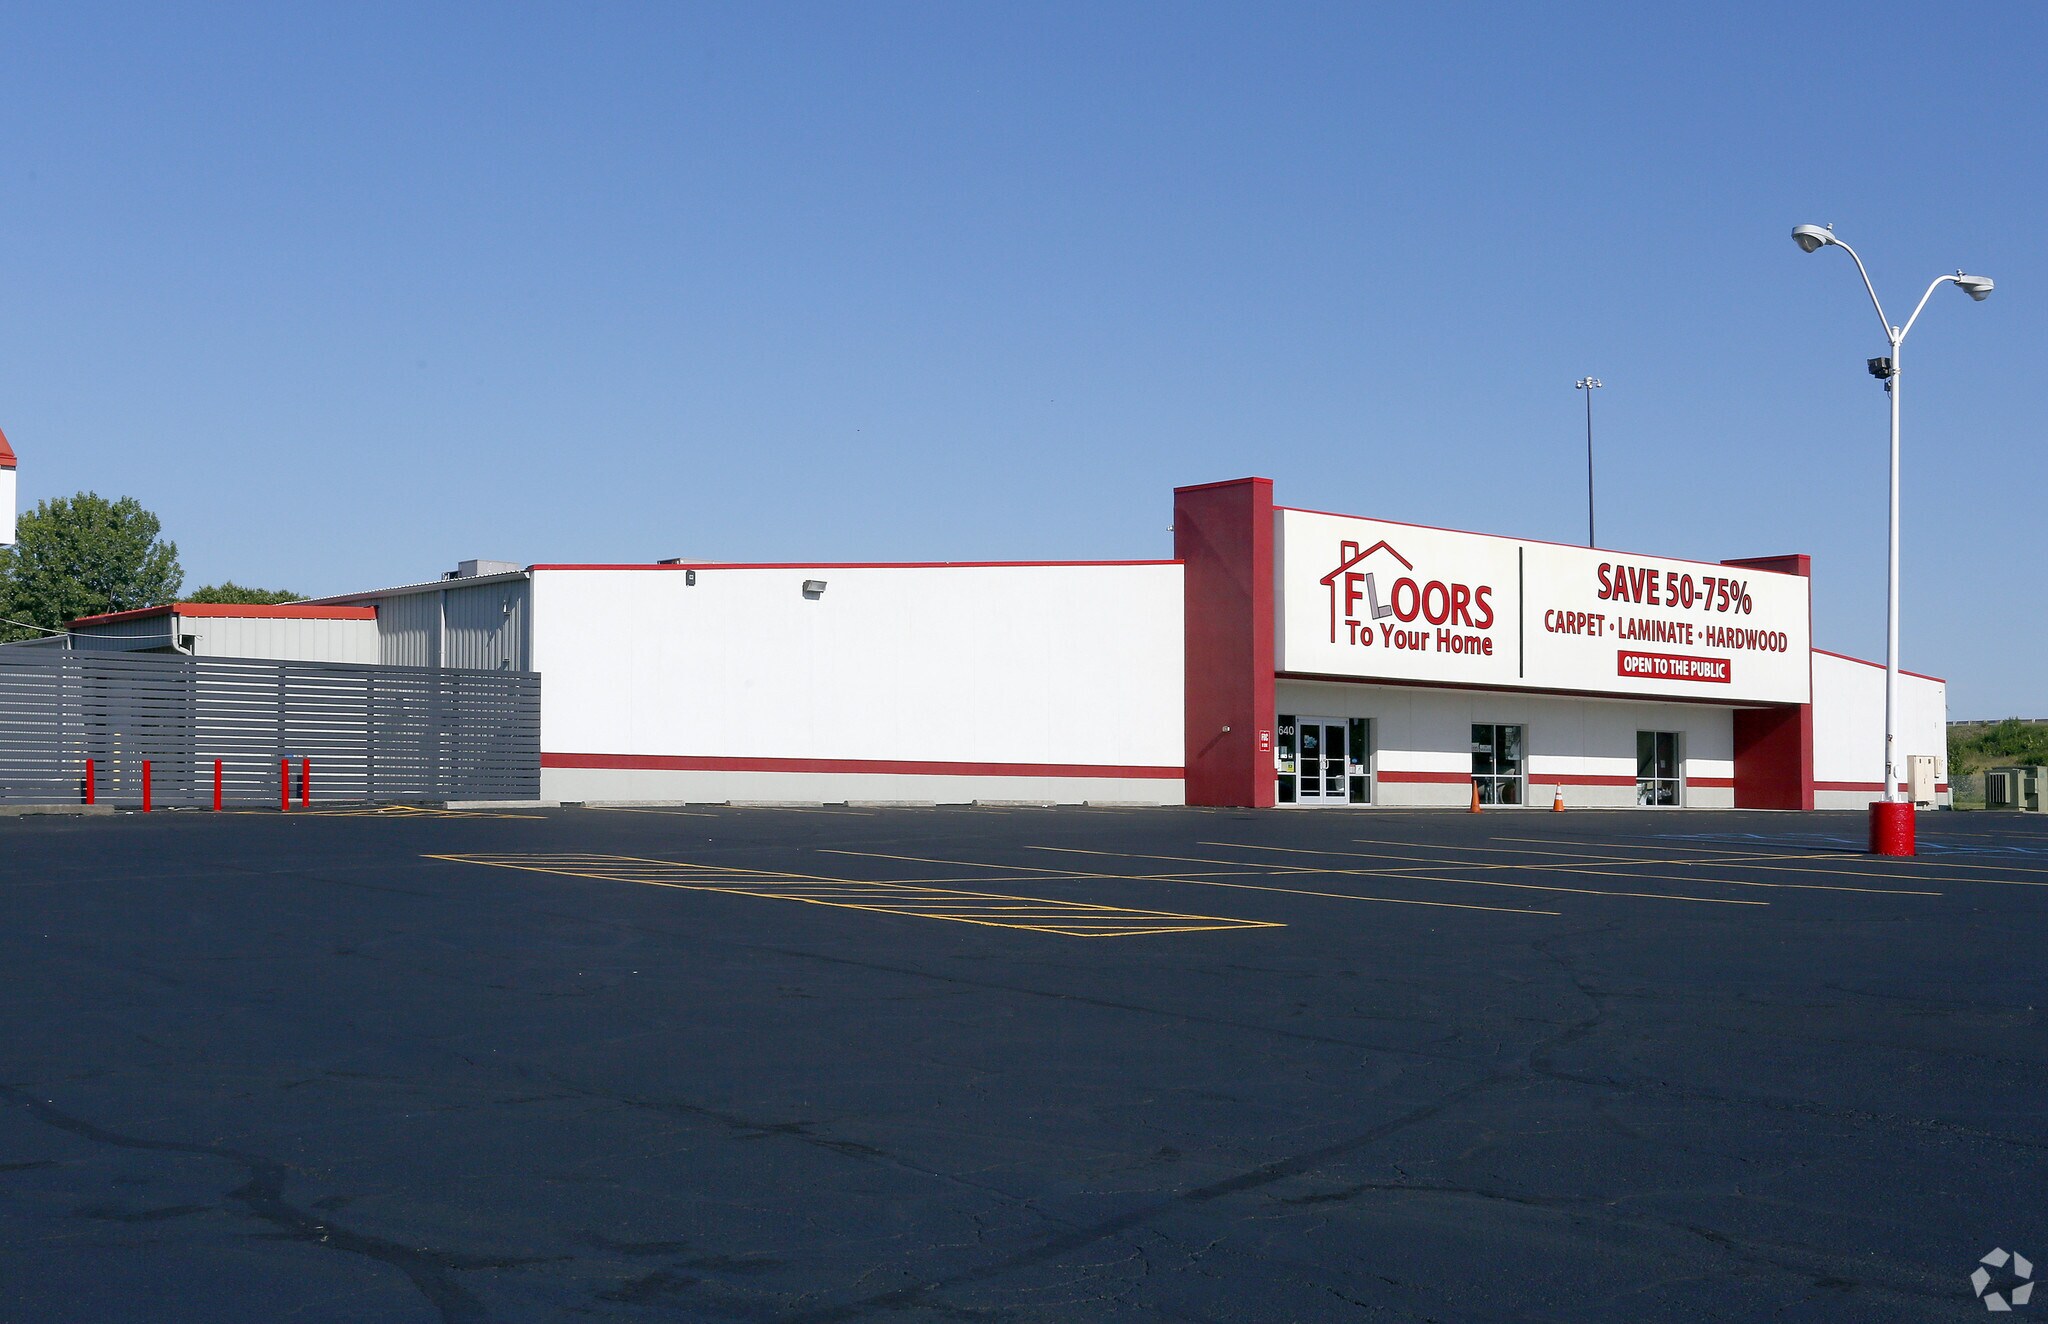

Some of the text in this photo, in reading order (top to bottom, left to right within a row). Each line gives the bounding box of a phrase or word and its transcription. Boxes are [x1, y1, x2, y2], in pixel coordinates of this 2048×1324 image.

[1345, 571, 1494, 629] FLOORS
[1597, 562, 1752, 615] SAVE 50-75%
[1345, 620, 1493, 656] To Your Home
[1544, 609, 1788, 653] CARPET LAMINATE HARDWOOD
[1624, 655, 1726, 679] OPEN TO THE PUBLIC
[1278, 726, 1295, 735] 640
